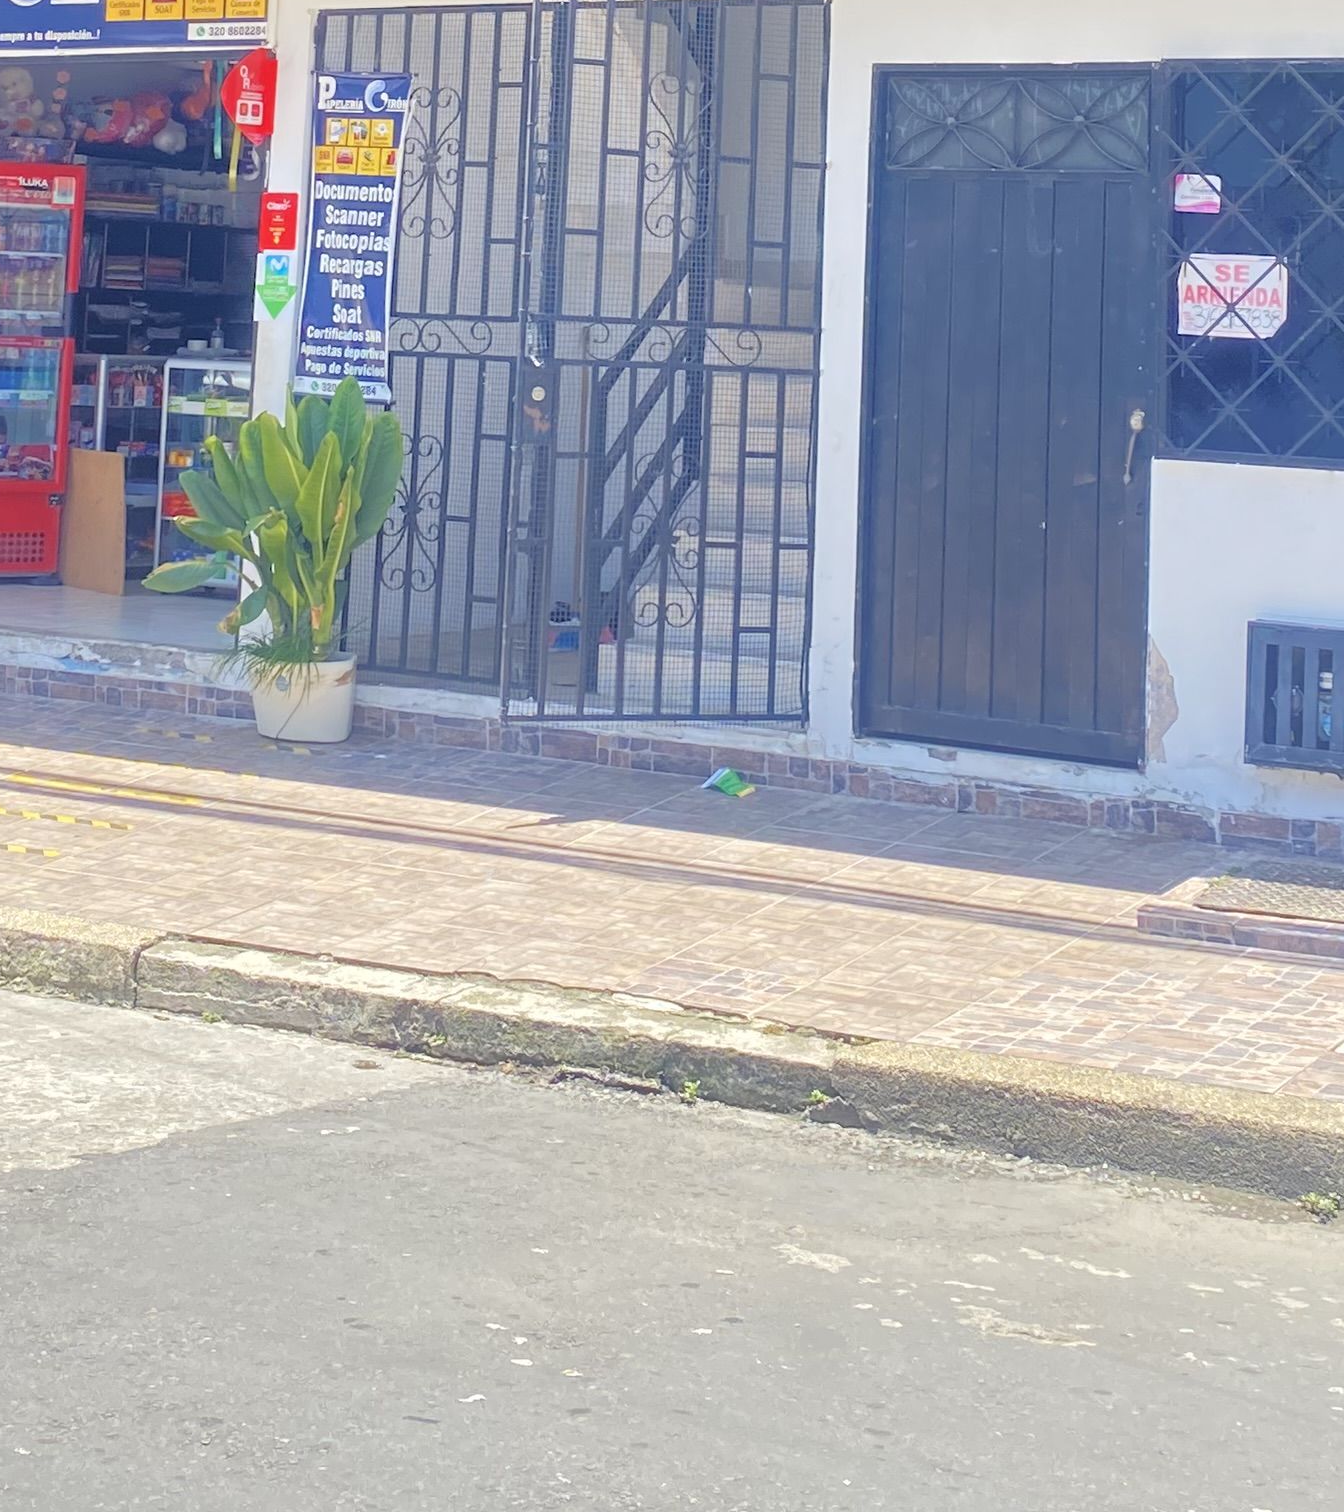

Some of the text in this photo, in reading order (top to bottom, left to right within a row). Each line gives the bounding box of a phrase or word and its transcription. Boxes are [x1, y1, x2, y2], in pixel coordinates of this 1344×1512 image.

[154, 5, 173, 14] SOAT
[26, 33, 33, 41] a
[34, 31, 43, 41] tu
[208, 27, 225, 36] 320
[325, 204, 385, 227] Scanner
[316, 229, 390, 255] Fotocopias
[319, 253, 384, 279] Recargas
[1215, 264, 1250, 283] SE
[331, 279, 365, 300] Pines
[1183, 284, 1282, 308] ARRIENDA
[332, 303, 362, 324] Soat
[306, 325, 382, 343] Certificados SNR
[301, 341, 343, 357] Apuestas
[305, 359, 385, 377] Pago de Servicios
